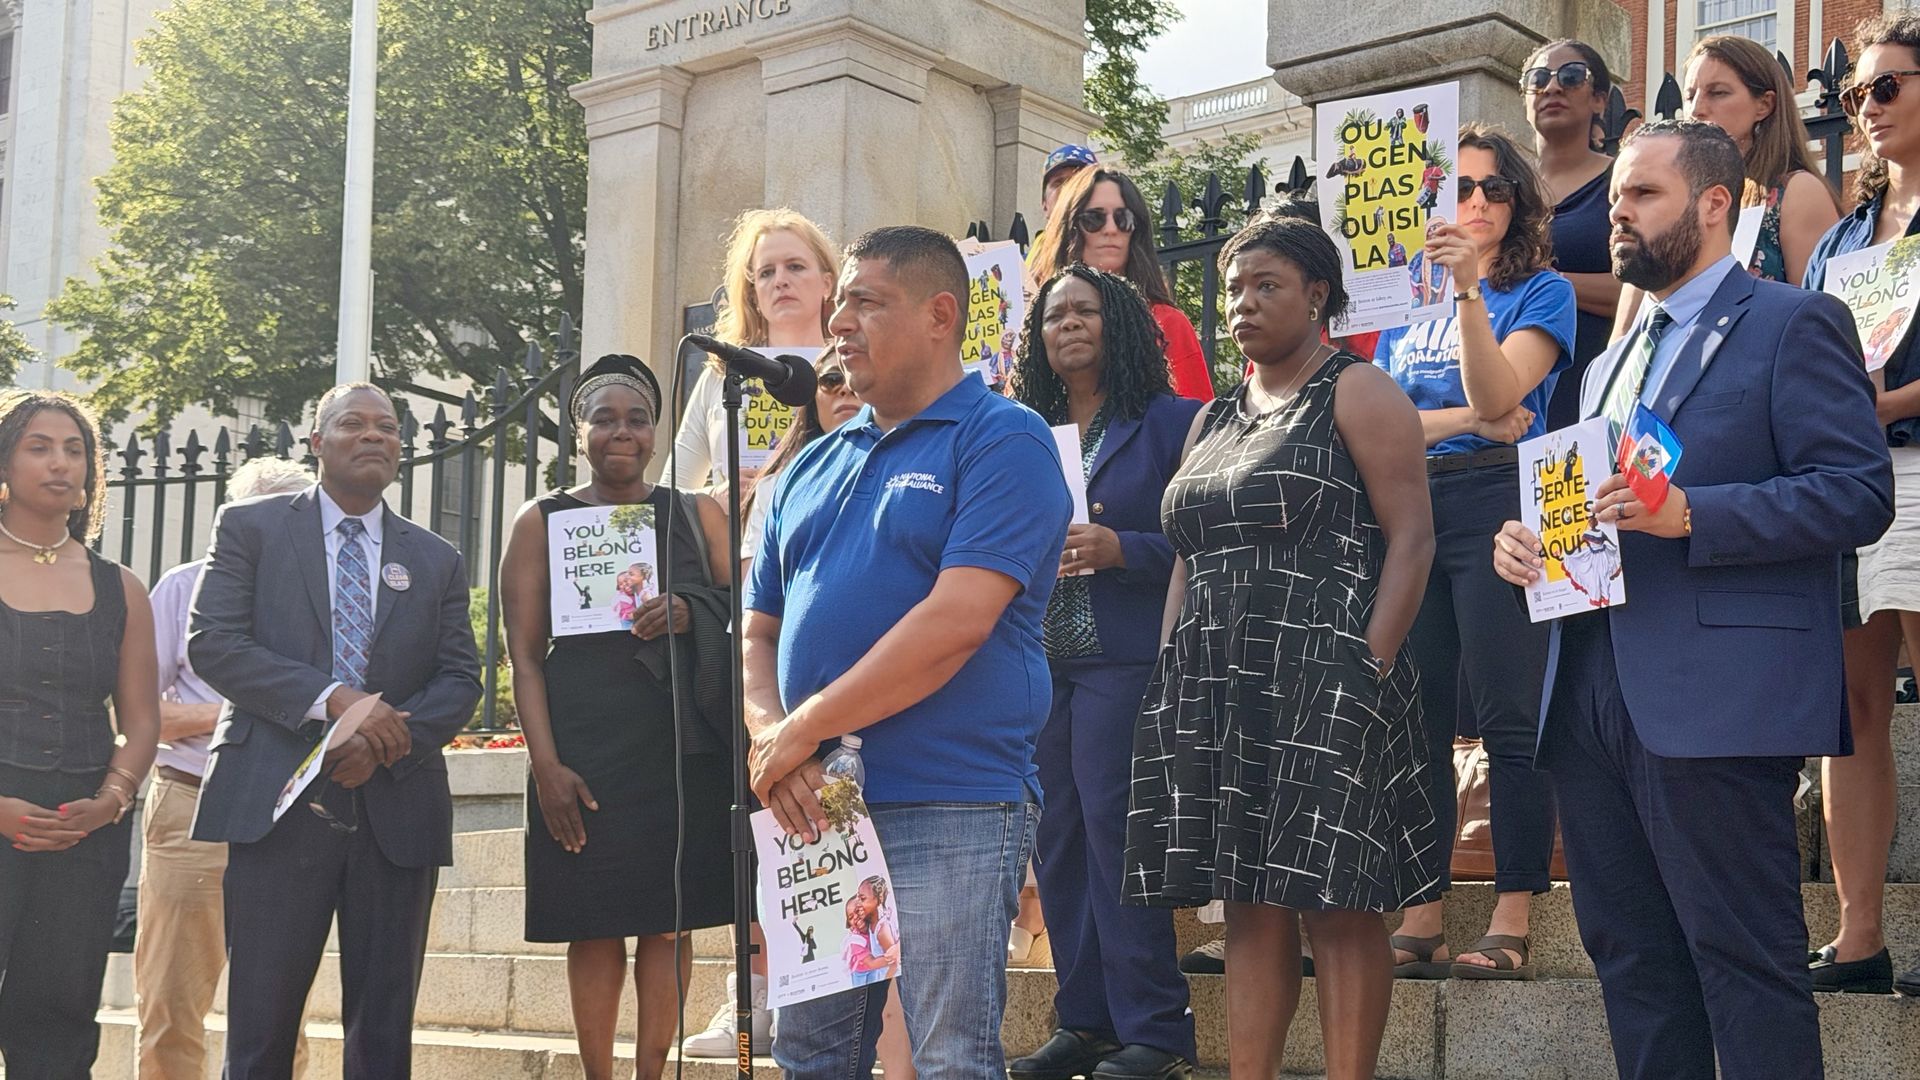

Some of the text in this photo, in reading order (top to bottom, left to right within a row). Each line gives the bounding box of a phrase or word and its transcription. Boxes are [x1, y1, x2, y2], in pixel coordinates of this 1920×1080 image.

[645, 0, 791, 51] ENTRANCE
[1341, 118, 1382, 144] OU
[1368, 140, 1426, 168] GEN
[1345, 174, 1414, 205] PLAS
[1341, 212, 1380, 239] OU
[1352, 245, 1386, 269] LA
[1840, 267, 1879, 292] YOU
[970, 287, 1003, 304] GEN
[1848, 280, 1909, 310] ELONG
[968, 306, 995, 323] LAS
[1856, 311, 1877, 329] RE
[961, 346, 979, 360] LA
[1397, 345, 1460, 372] COALITIO
[745, 417, 768, 429] OU
[748, 434, 768, 446] LA
[900, 472, 937, 483] NATIONAL
[908, 480, 945, 494] ALLIANCE
[563, 524, 605, 541] YOU
[563, 541, 642, 561] BELONG
[564, 561, 616, 579] HERE
[776, 842, 869, 889] BELONG
[781, 882, 843, 920] HERE
